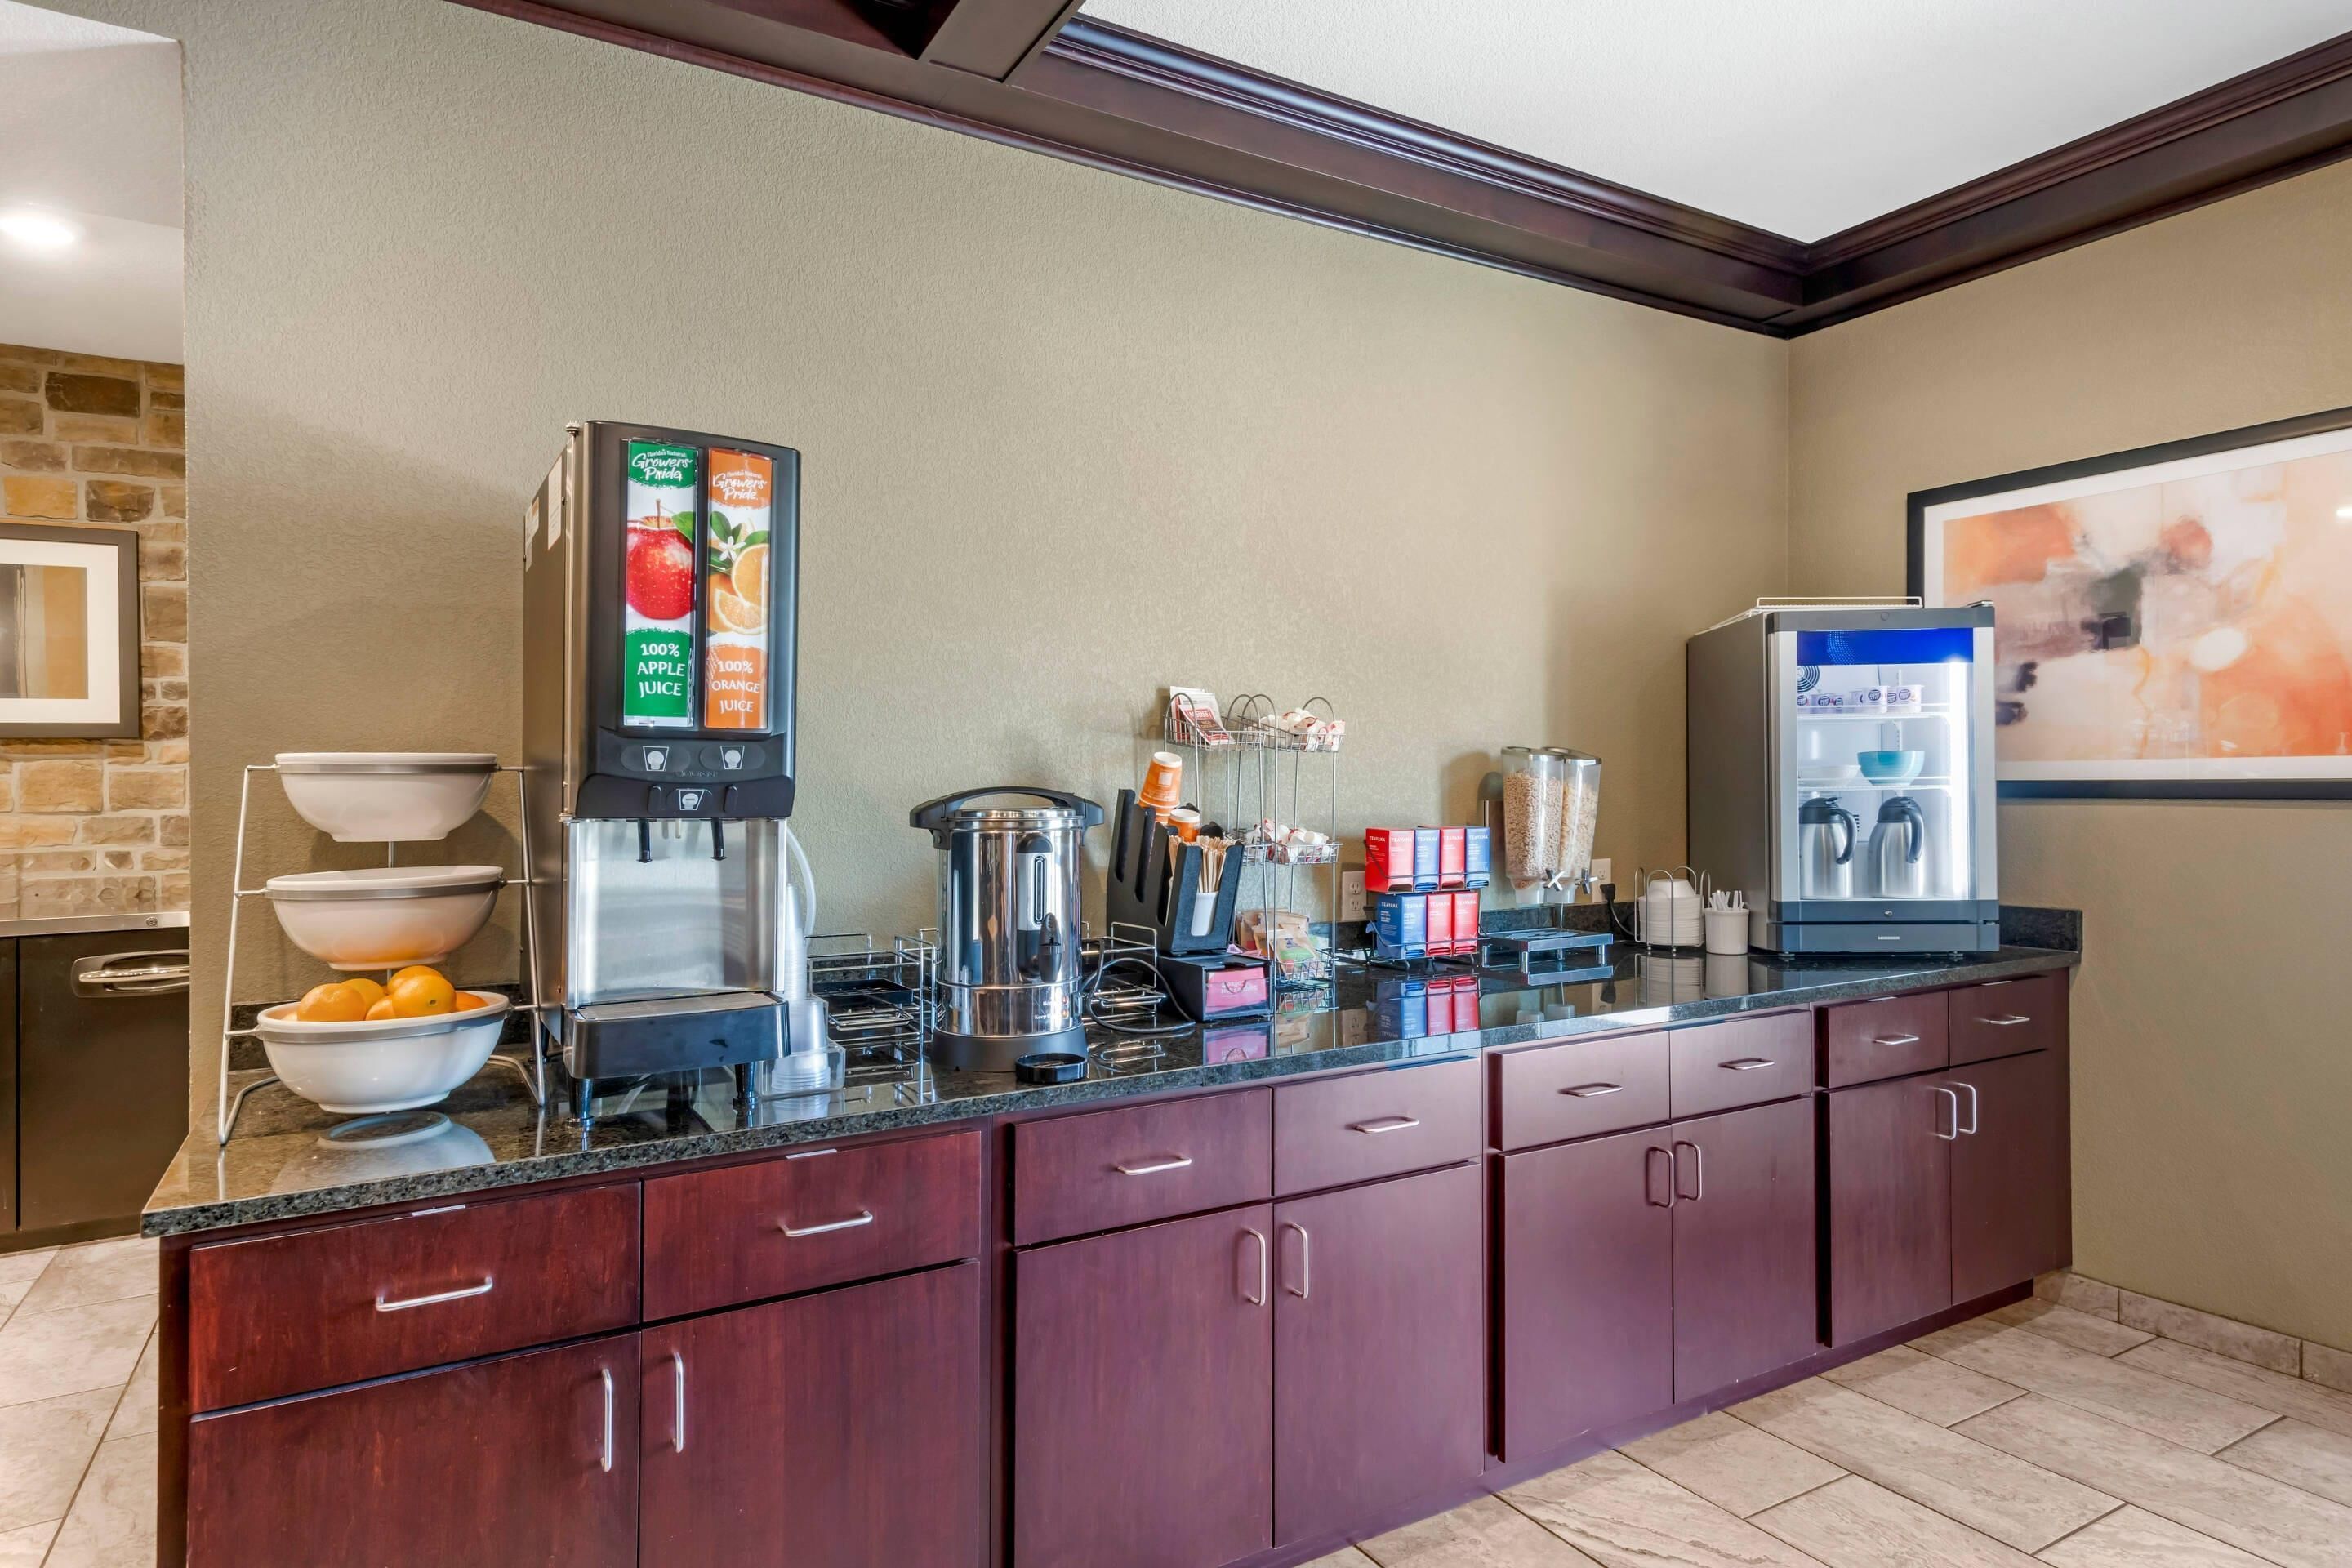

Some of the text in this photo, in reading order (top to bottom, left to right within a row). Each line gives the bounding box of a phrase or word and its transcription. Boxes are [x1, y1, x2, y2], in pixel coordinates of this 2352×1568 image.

[632, 452, 693, 469] Growers
[644, 466, 681, 482] Pride
[712, 473, 768, 490] Growers
[723, 487, 756, 501] Pride
[640, 643, 679, 657] 100%
[637, 662, 685, 676] APPLE
[718, 660, 753, 674] 100%
[639, 681, 682, 698] JUICE
[711, 679, 760, 693] ORANGE
[719, 699, 754, 714] JUICE
